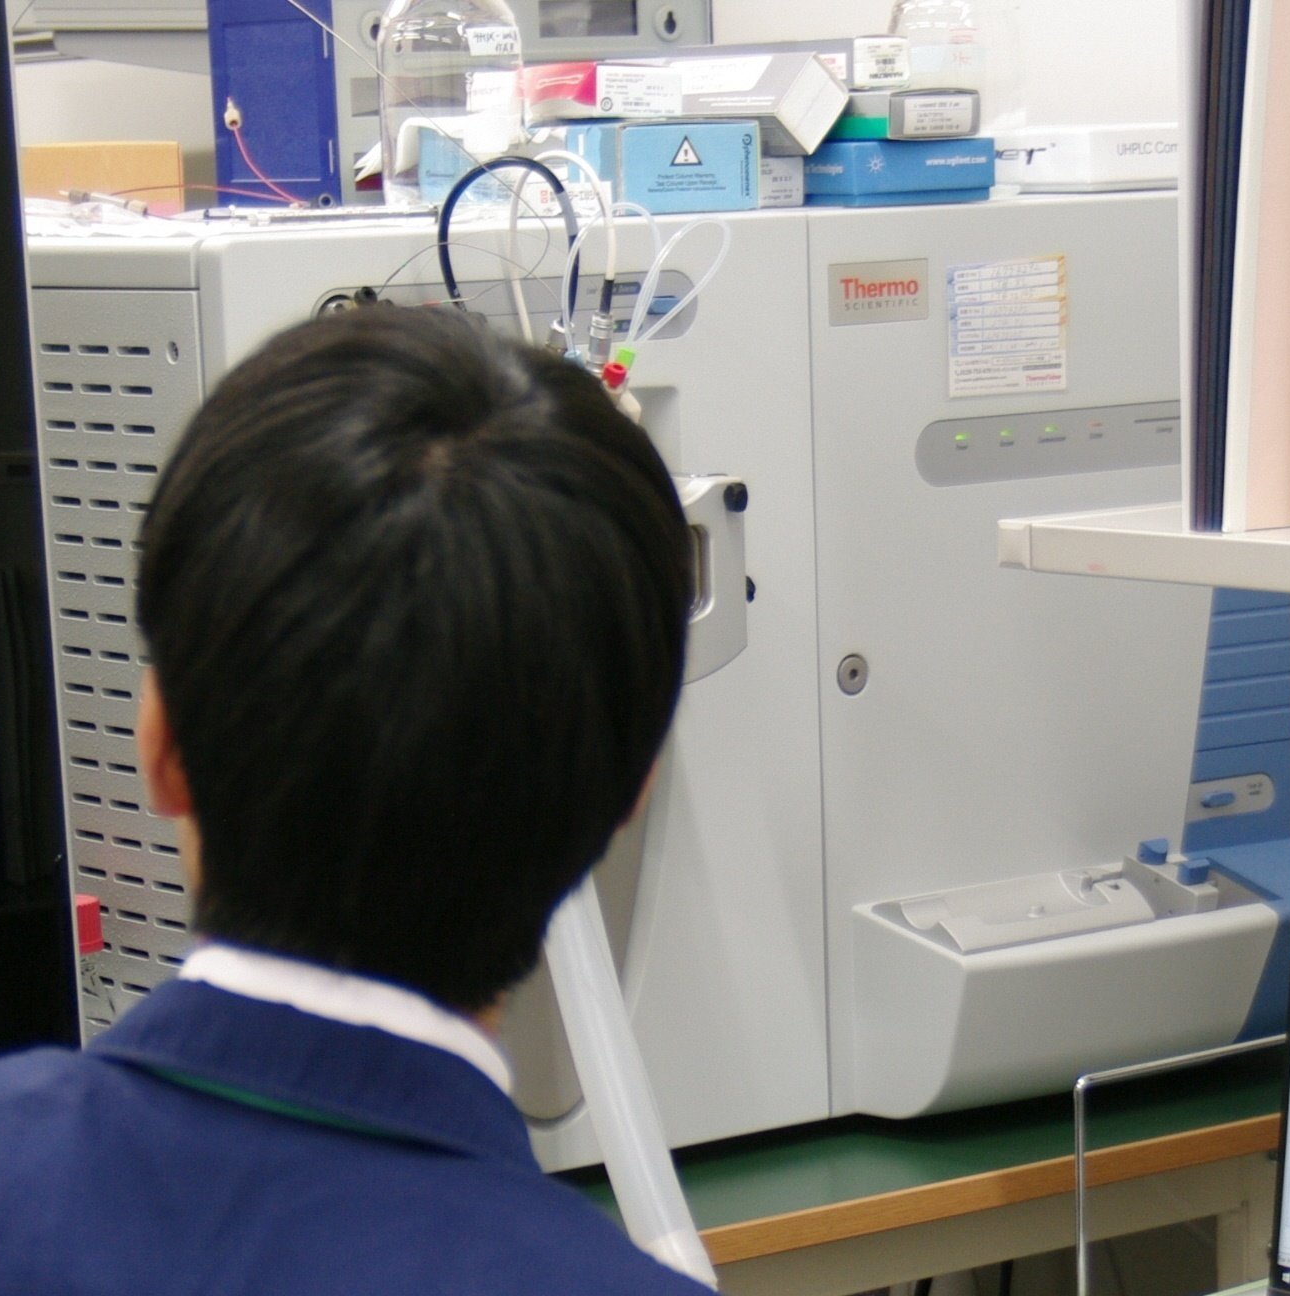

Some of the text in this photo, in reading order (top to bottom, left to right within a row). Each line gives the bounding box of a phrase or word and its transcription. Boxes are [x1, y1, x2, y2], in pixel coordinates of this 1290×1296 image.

[1116, 141, 1152, 156] UHPLC
[839, 275, 919, 302] Thermo
[844, 298, 919, 312] SCIENTIFIC
